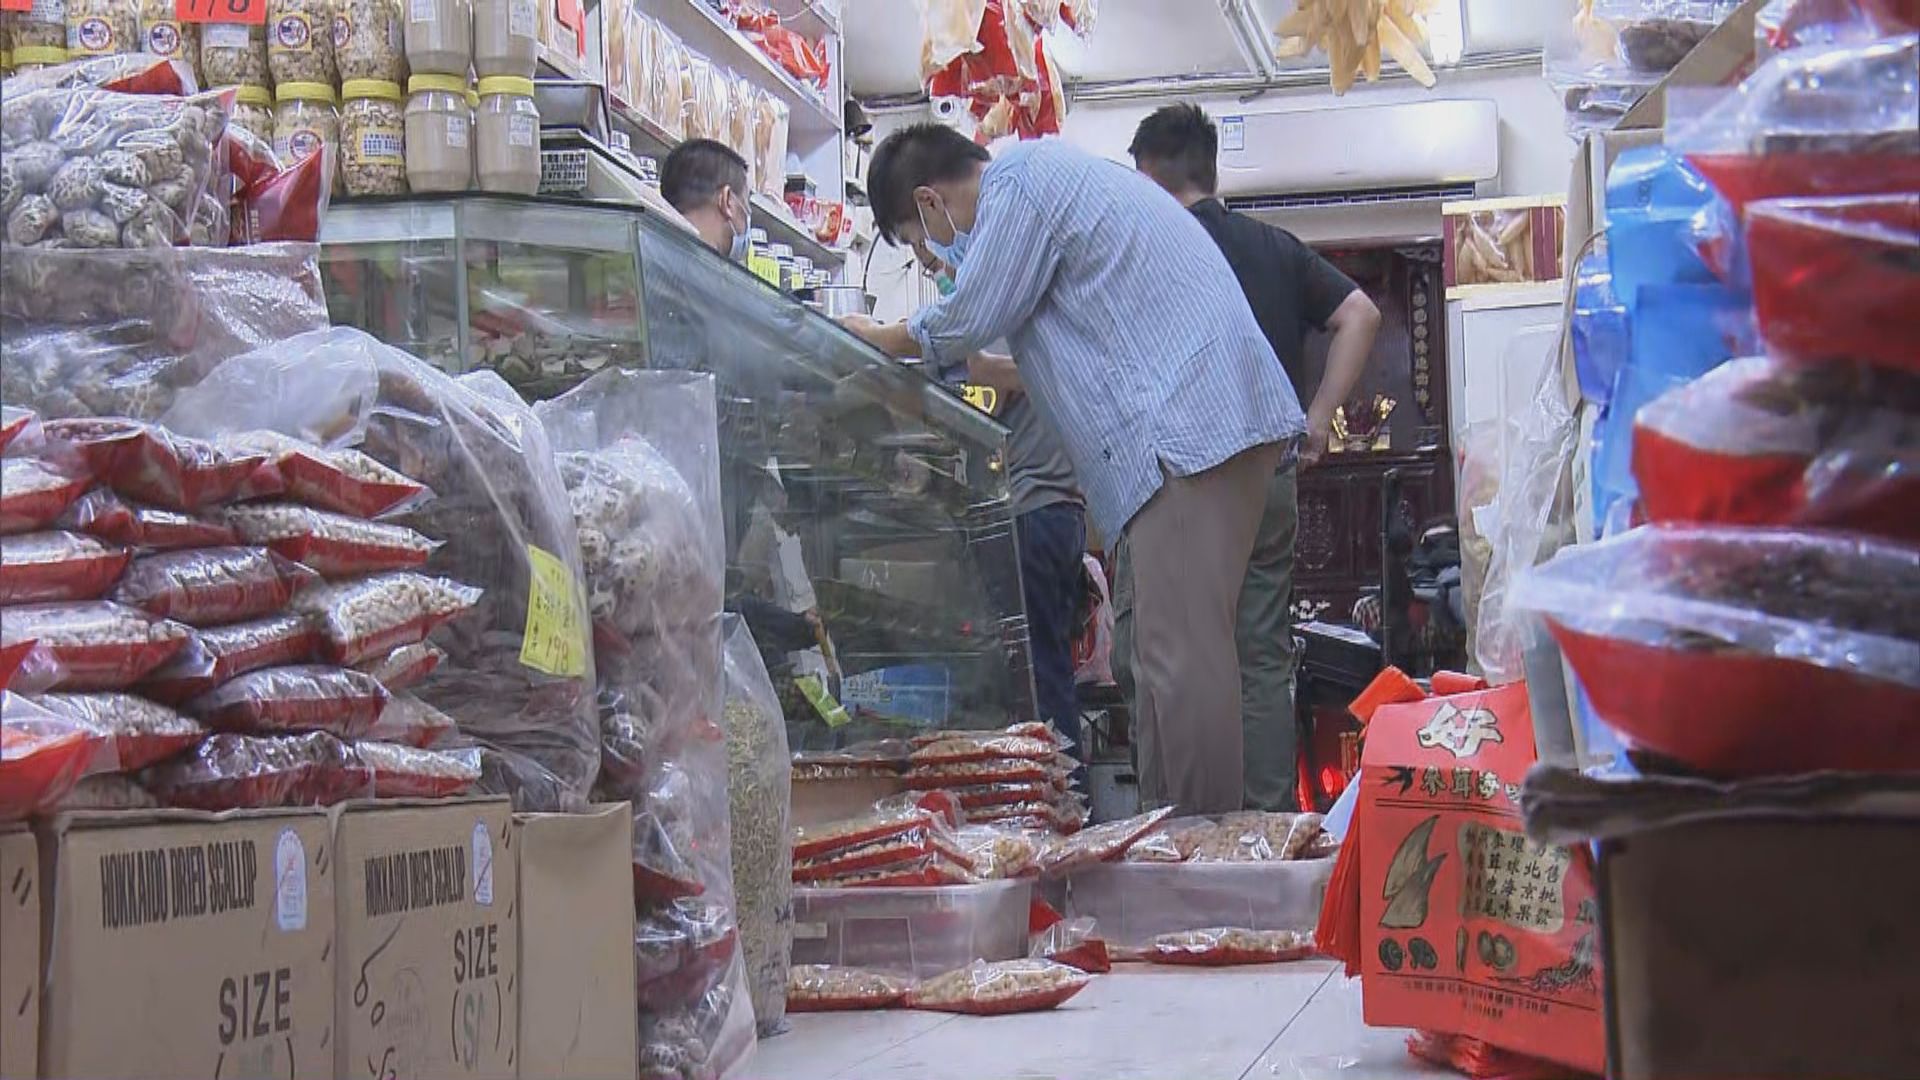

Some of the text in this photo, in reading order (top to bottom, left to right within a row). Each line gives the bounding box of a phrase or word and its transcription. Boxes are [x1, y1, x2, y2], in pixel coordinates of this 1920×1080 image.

[100, 850, 169, 929] HOKKAIDO
[169, 845, 206, 918] DRIED
[208, 839, 257, 915] SCALLOP
[365, 852, 409, 917] HOKKAIDO
[409, 849, 433, 911] DRIED
[433, 844, 466, 907] SCALLOP
[453, 923, 498, 984] SIZE
[219, 966, 291, 1046] SIZE
